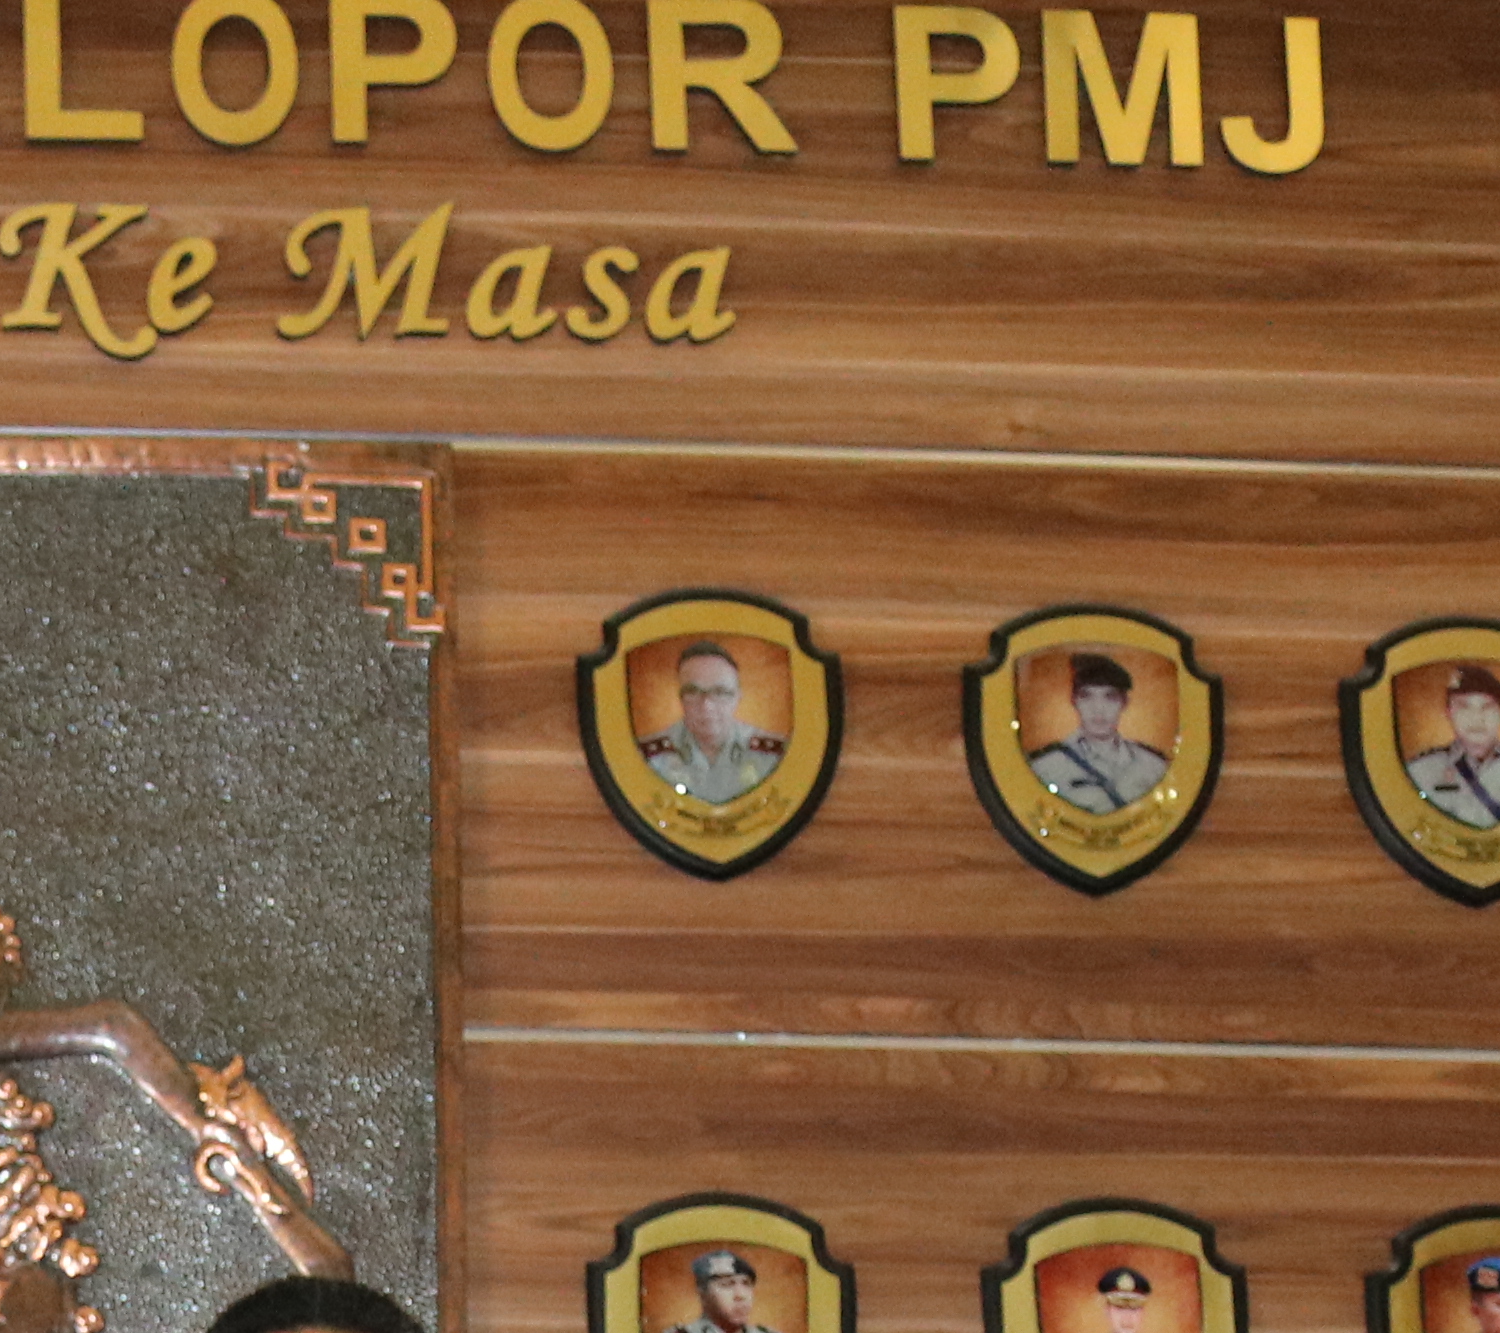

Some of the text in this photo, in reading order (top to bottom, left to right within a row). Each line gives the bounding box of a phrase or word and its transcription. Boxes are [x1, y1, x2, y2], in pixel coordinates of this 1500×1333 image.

[896, 5, 1324, 175] PMJ
[0, 199, 218, 362] Ke
[276, 199, 738, 343] Masa
